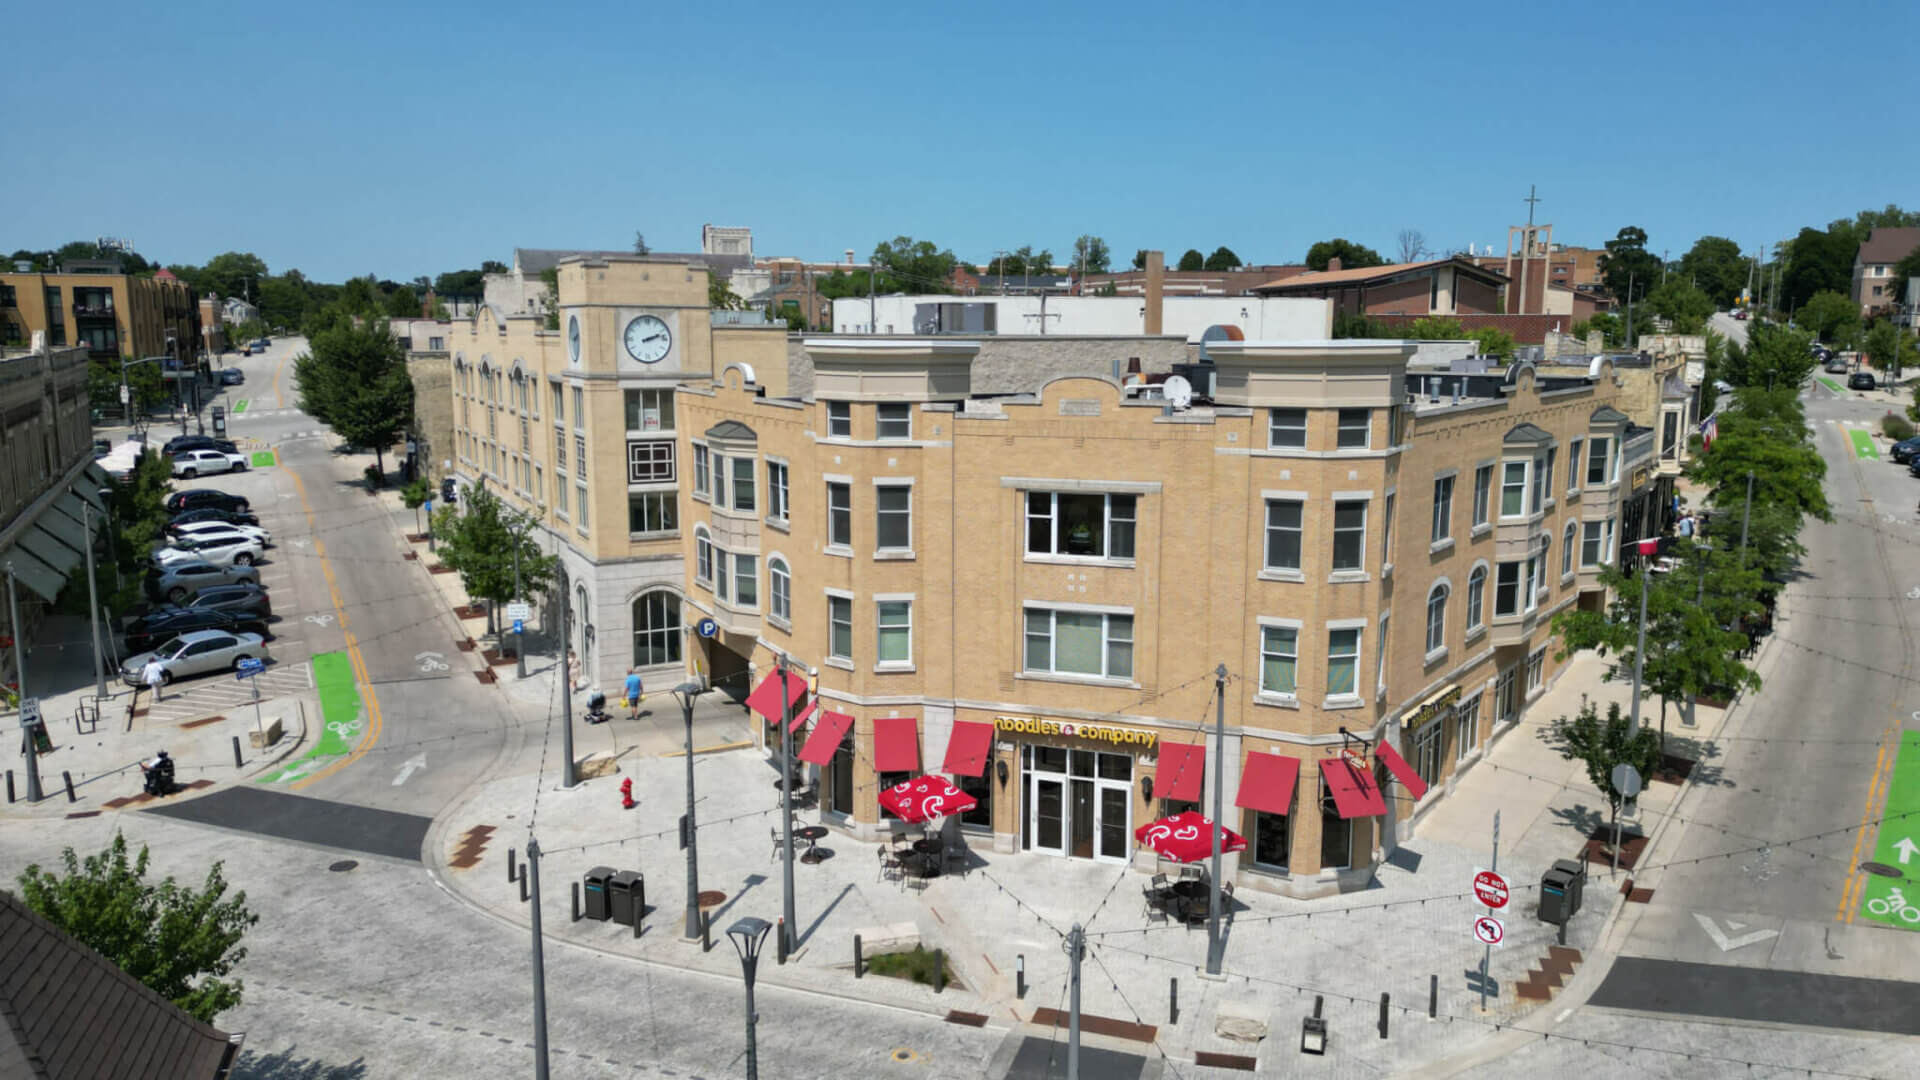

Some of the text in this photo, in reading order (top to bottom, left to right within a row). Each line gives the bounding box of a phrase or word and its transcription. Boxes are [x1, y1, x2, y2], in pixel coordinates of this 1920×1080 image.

[703, 622, 714, 634] P
[993, 716, 1059, 735] noodles
[1078, 725, 1158, 748] company
[1479, 875, 1504, 888] DO NOT
[1481, 892, 1501, 904] ENTER
